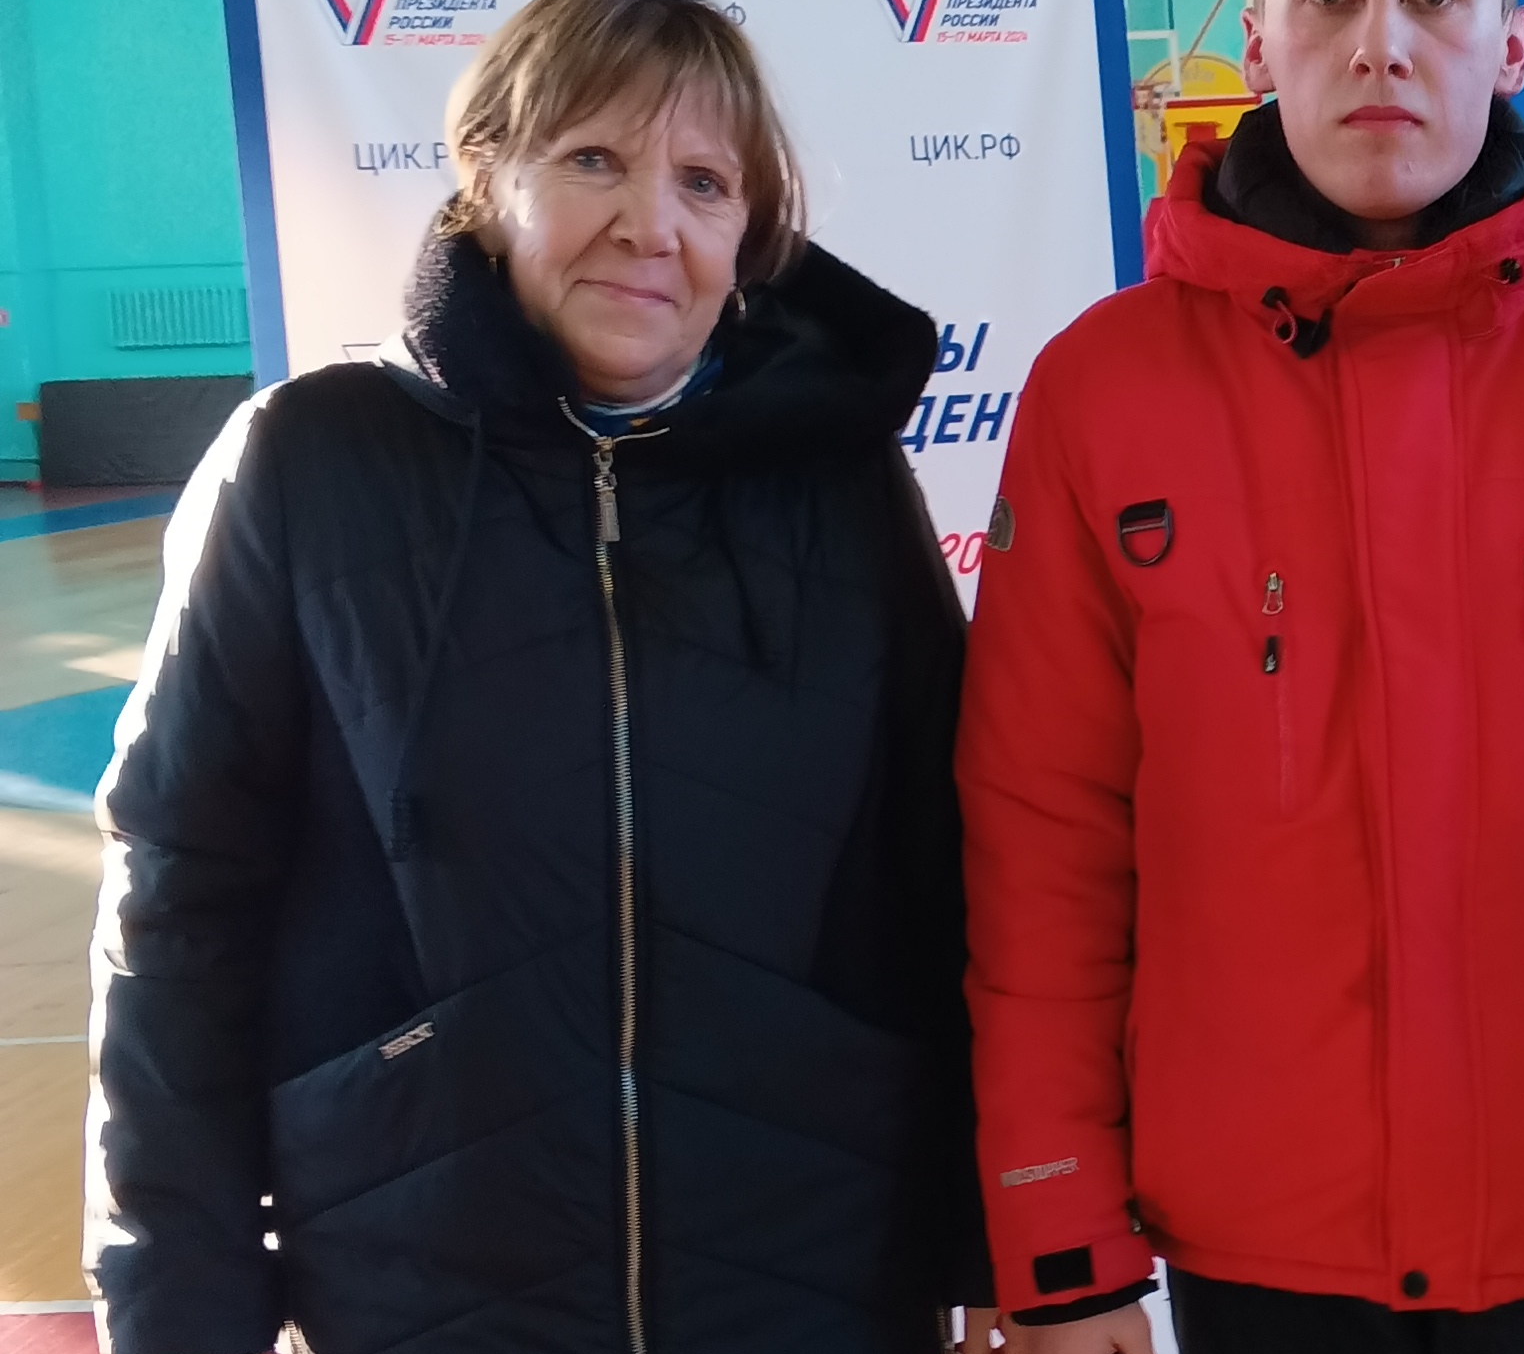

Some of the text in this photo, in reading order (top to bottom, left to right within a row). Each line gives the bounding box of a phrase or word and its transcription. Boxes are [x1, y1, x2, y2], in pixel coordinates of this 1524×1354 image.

[387, 15, 455, 30] РОССИИ
[940, 14, 1001, 27] РОССИИ
[353, 141, 449, 176] ЦИК.Р
[910, 133, 1021, 166] ЦИК.РФ
